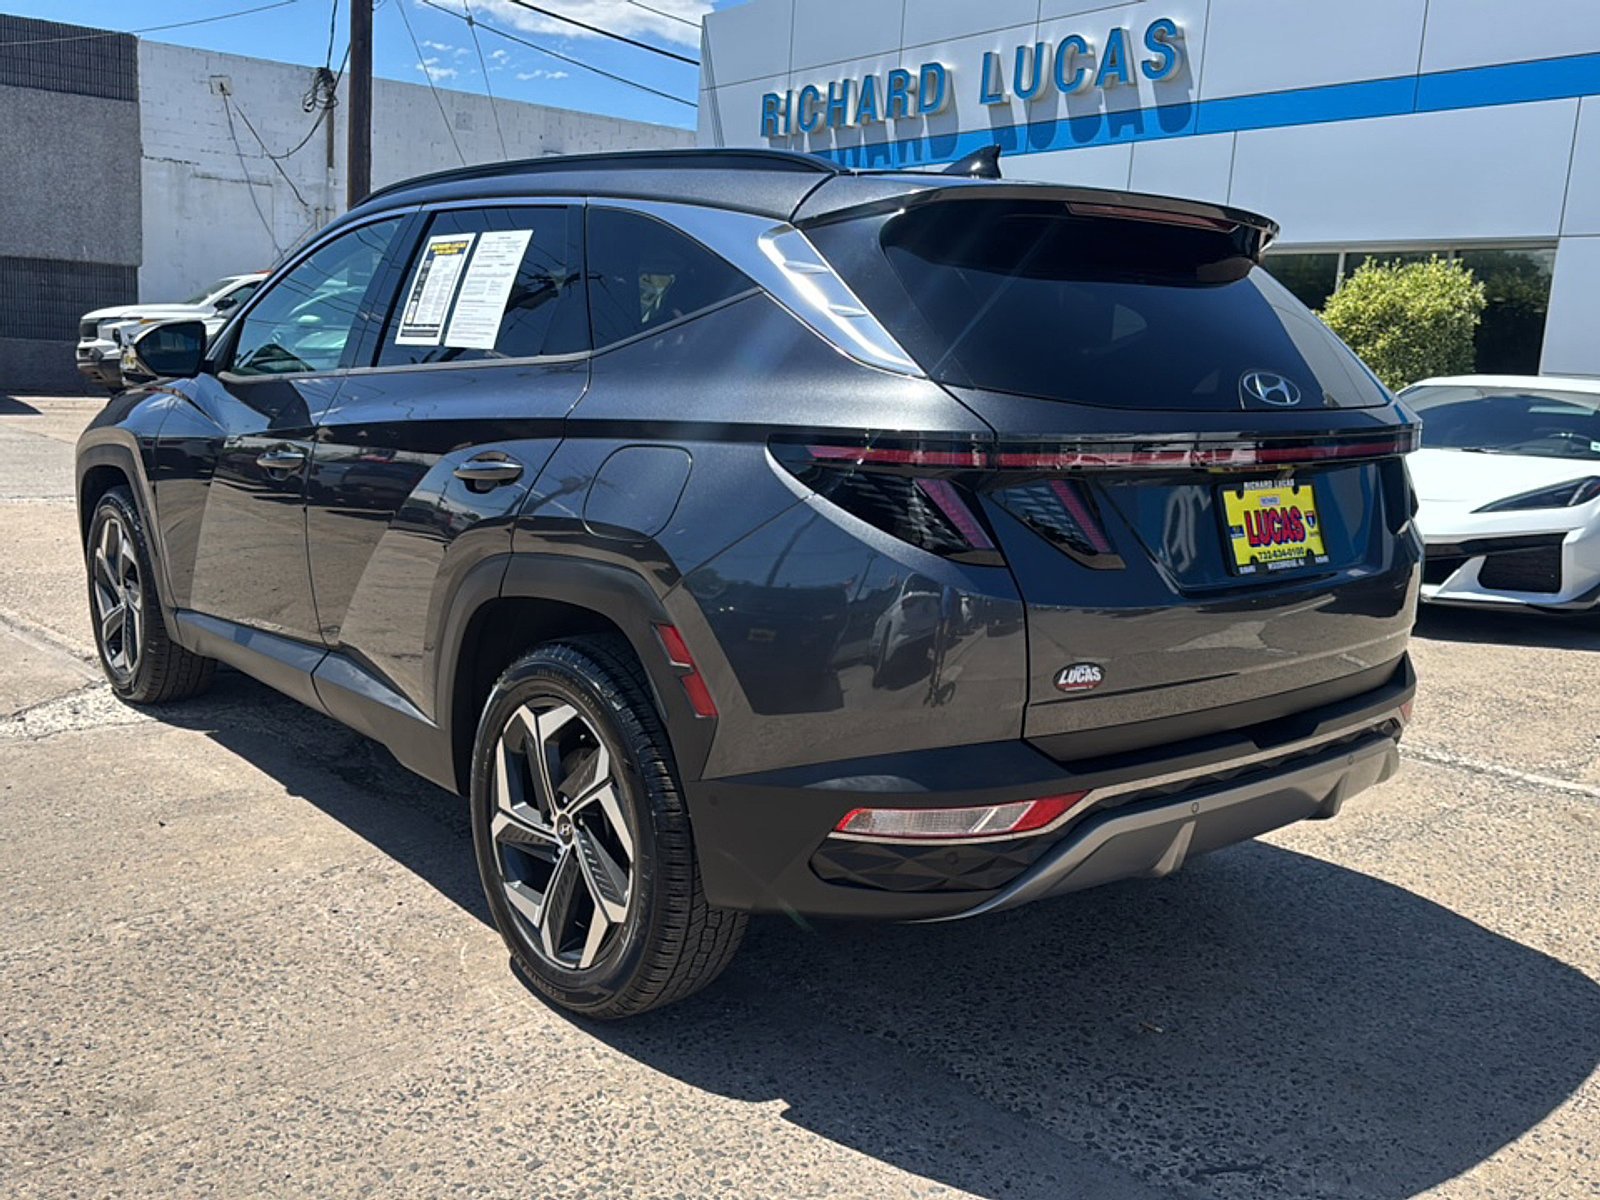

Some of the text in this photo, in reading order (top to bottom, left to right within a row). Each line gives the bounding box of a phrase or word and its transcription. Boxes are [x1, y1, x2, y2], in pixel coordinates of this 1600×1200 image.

[760, 17, 1185, 138] RICHARD LUCAS
[1244, 506, 1306, 547] LUCAS
[1058, 667, 1102, 685] LUCAS
